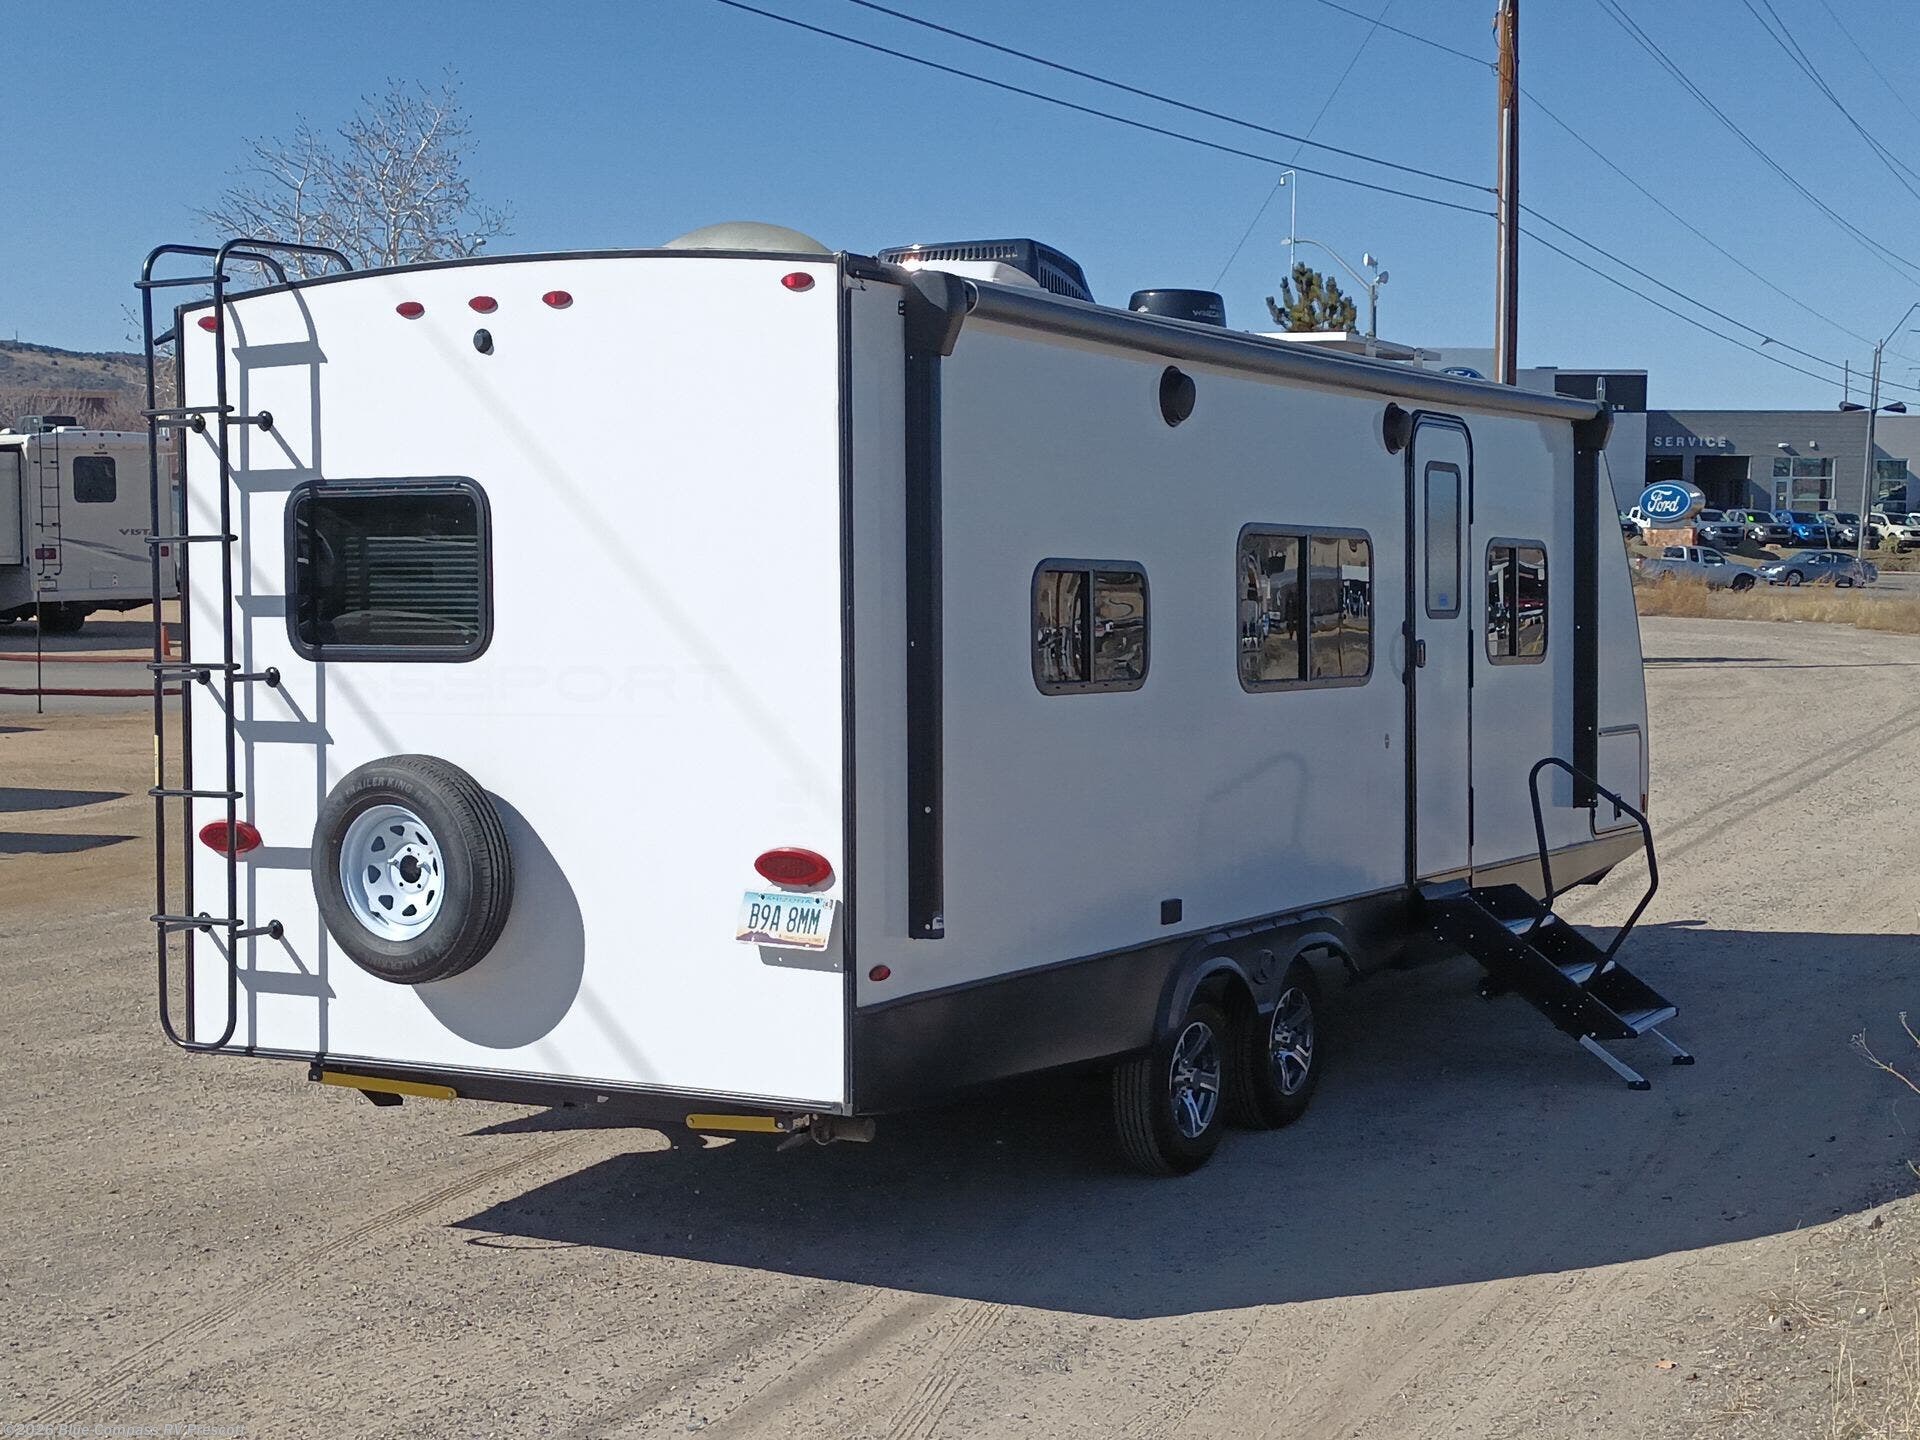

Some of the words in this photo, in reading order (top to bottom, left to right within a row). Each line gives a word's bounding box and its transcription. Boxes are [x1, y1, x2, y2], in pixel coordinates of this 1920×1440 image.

[1654, 436, 1726, 448] SERVICE
[1647, 489, 1681, 512] Ford
[387, 776, 414, 793] KING
[748, 903, 781, 931] B9A
[786, 906, 822, 935] 8MM
